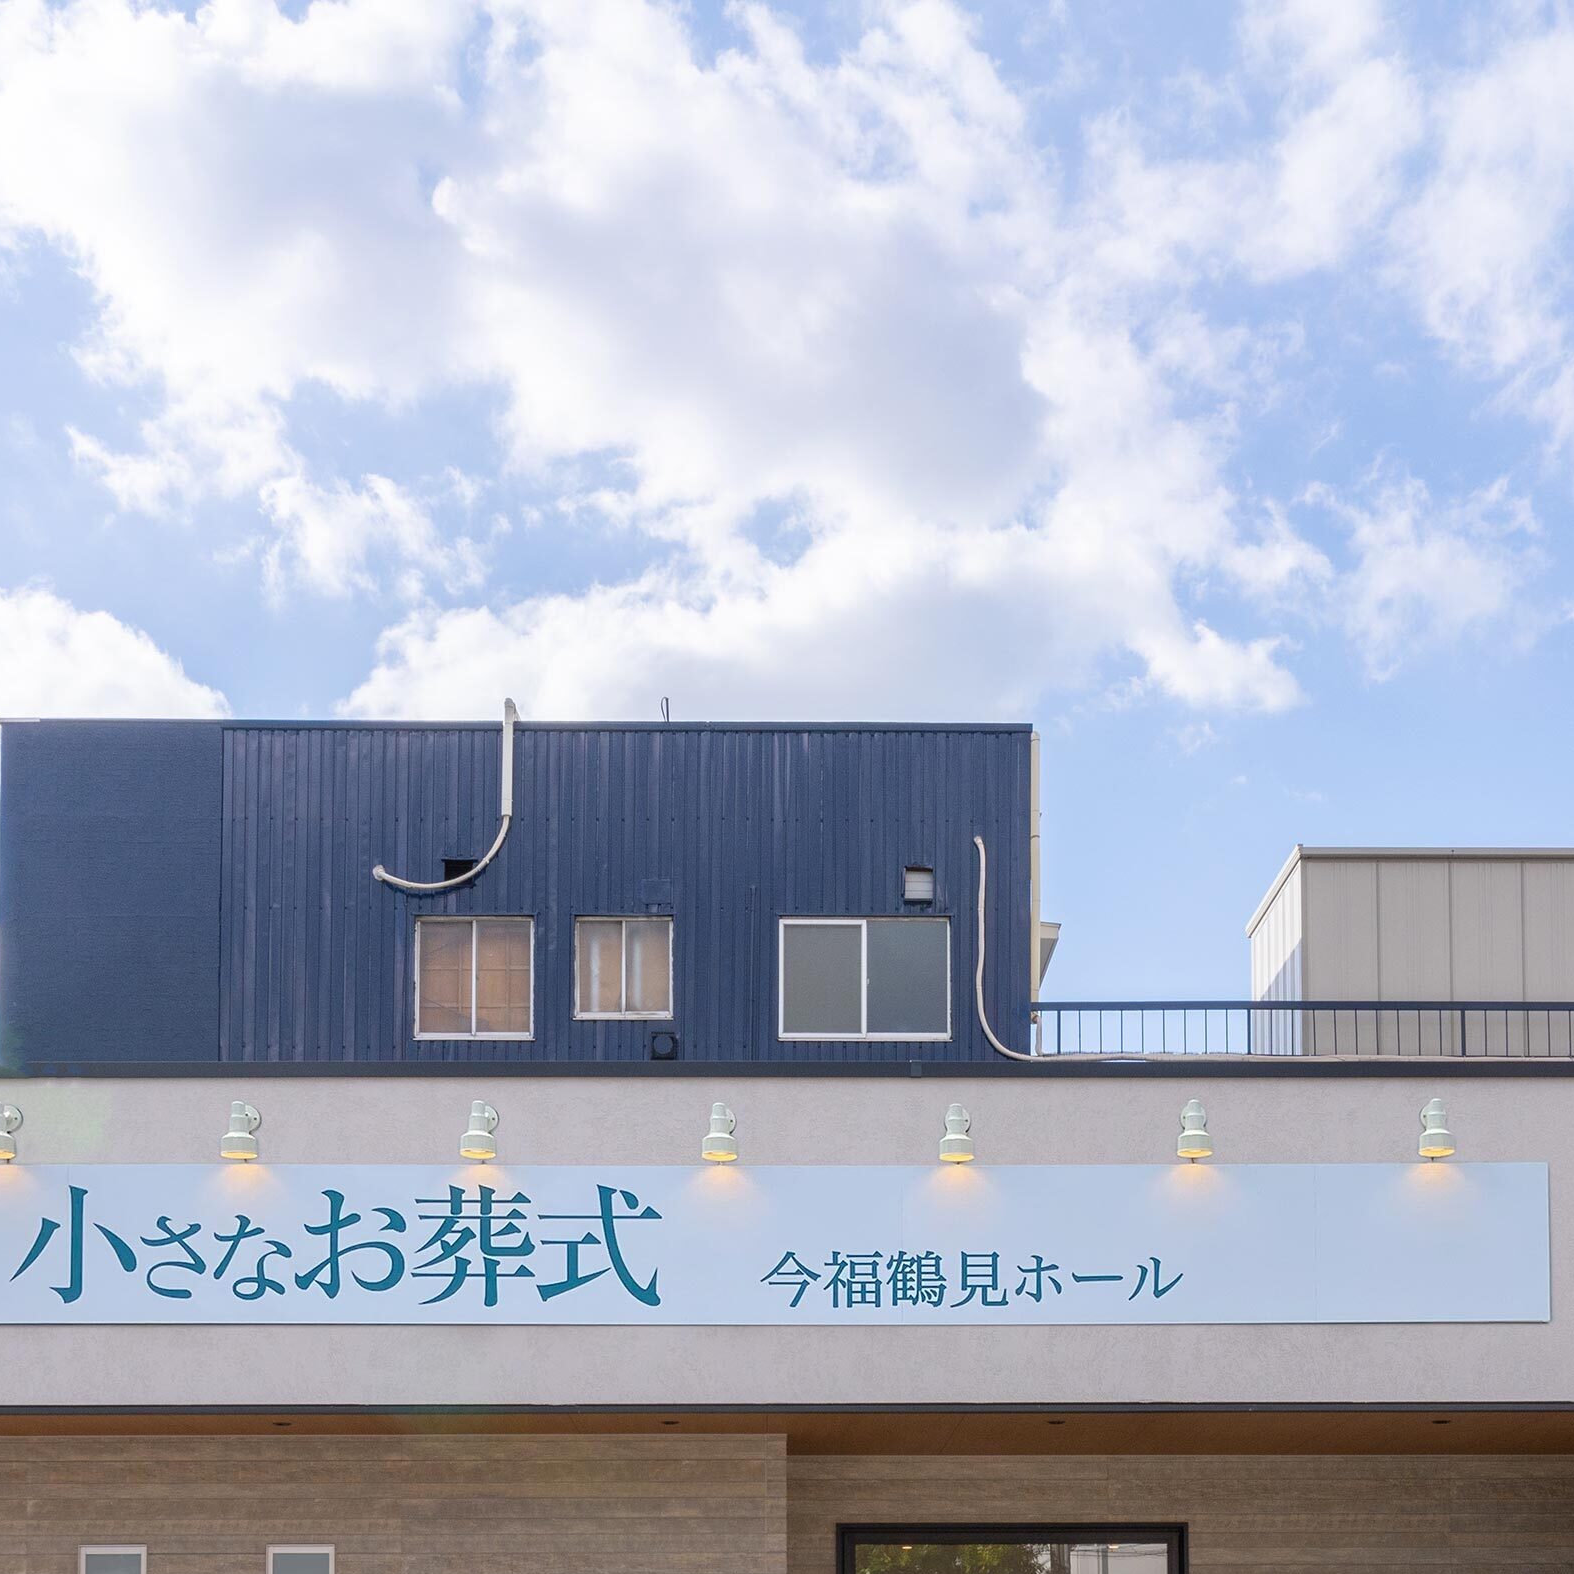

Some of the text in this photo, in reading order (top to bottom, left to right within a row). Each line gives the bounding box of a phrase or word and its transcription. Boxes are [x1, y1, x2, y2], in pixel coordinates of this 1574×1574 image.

[8, 1184, 1185, 1310] 小さなお葬式 今福鶴見ホール
